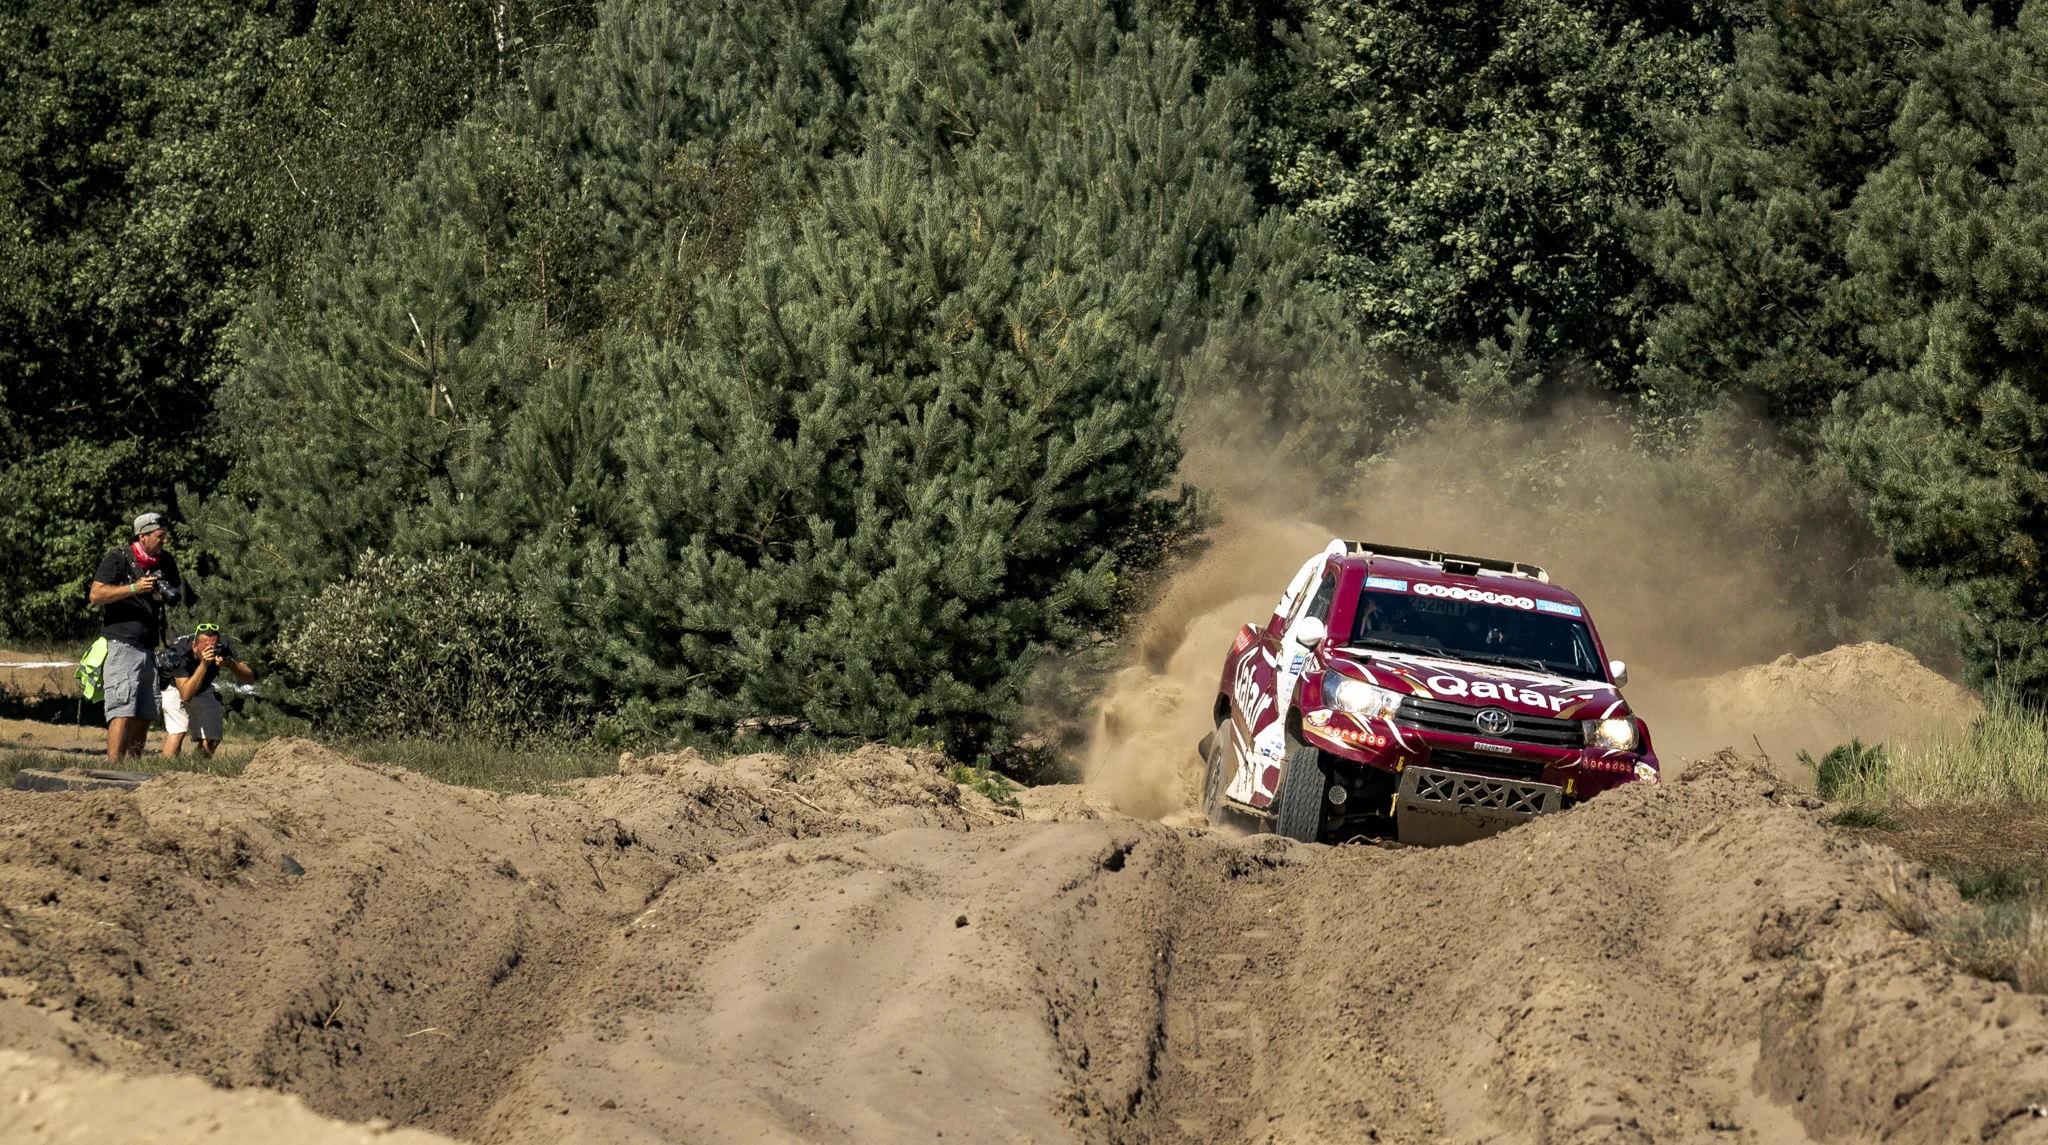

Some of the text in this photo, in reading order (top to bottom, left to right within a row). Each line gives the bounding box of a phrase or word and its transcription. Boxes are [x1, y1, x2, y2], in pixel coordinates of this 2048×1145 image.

[1416, 585, 1532, 608] ooredoo
[1235, 646, 1273, 733] Qatar
[1427, 676, 1571, 712] Qatar
[1323, 727, 1386, 746] ooredoo
[1583, 758, 1632, 773] ooredoo
